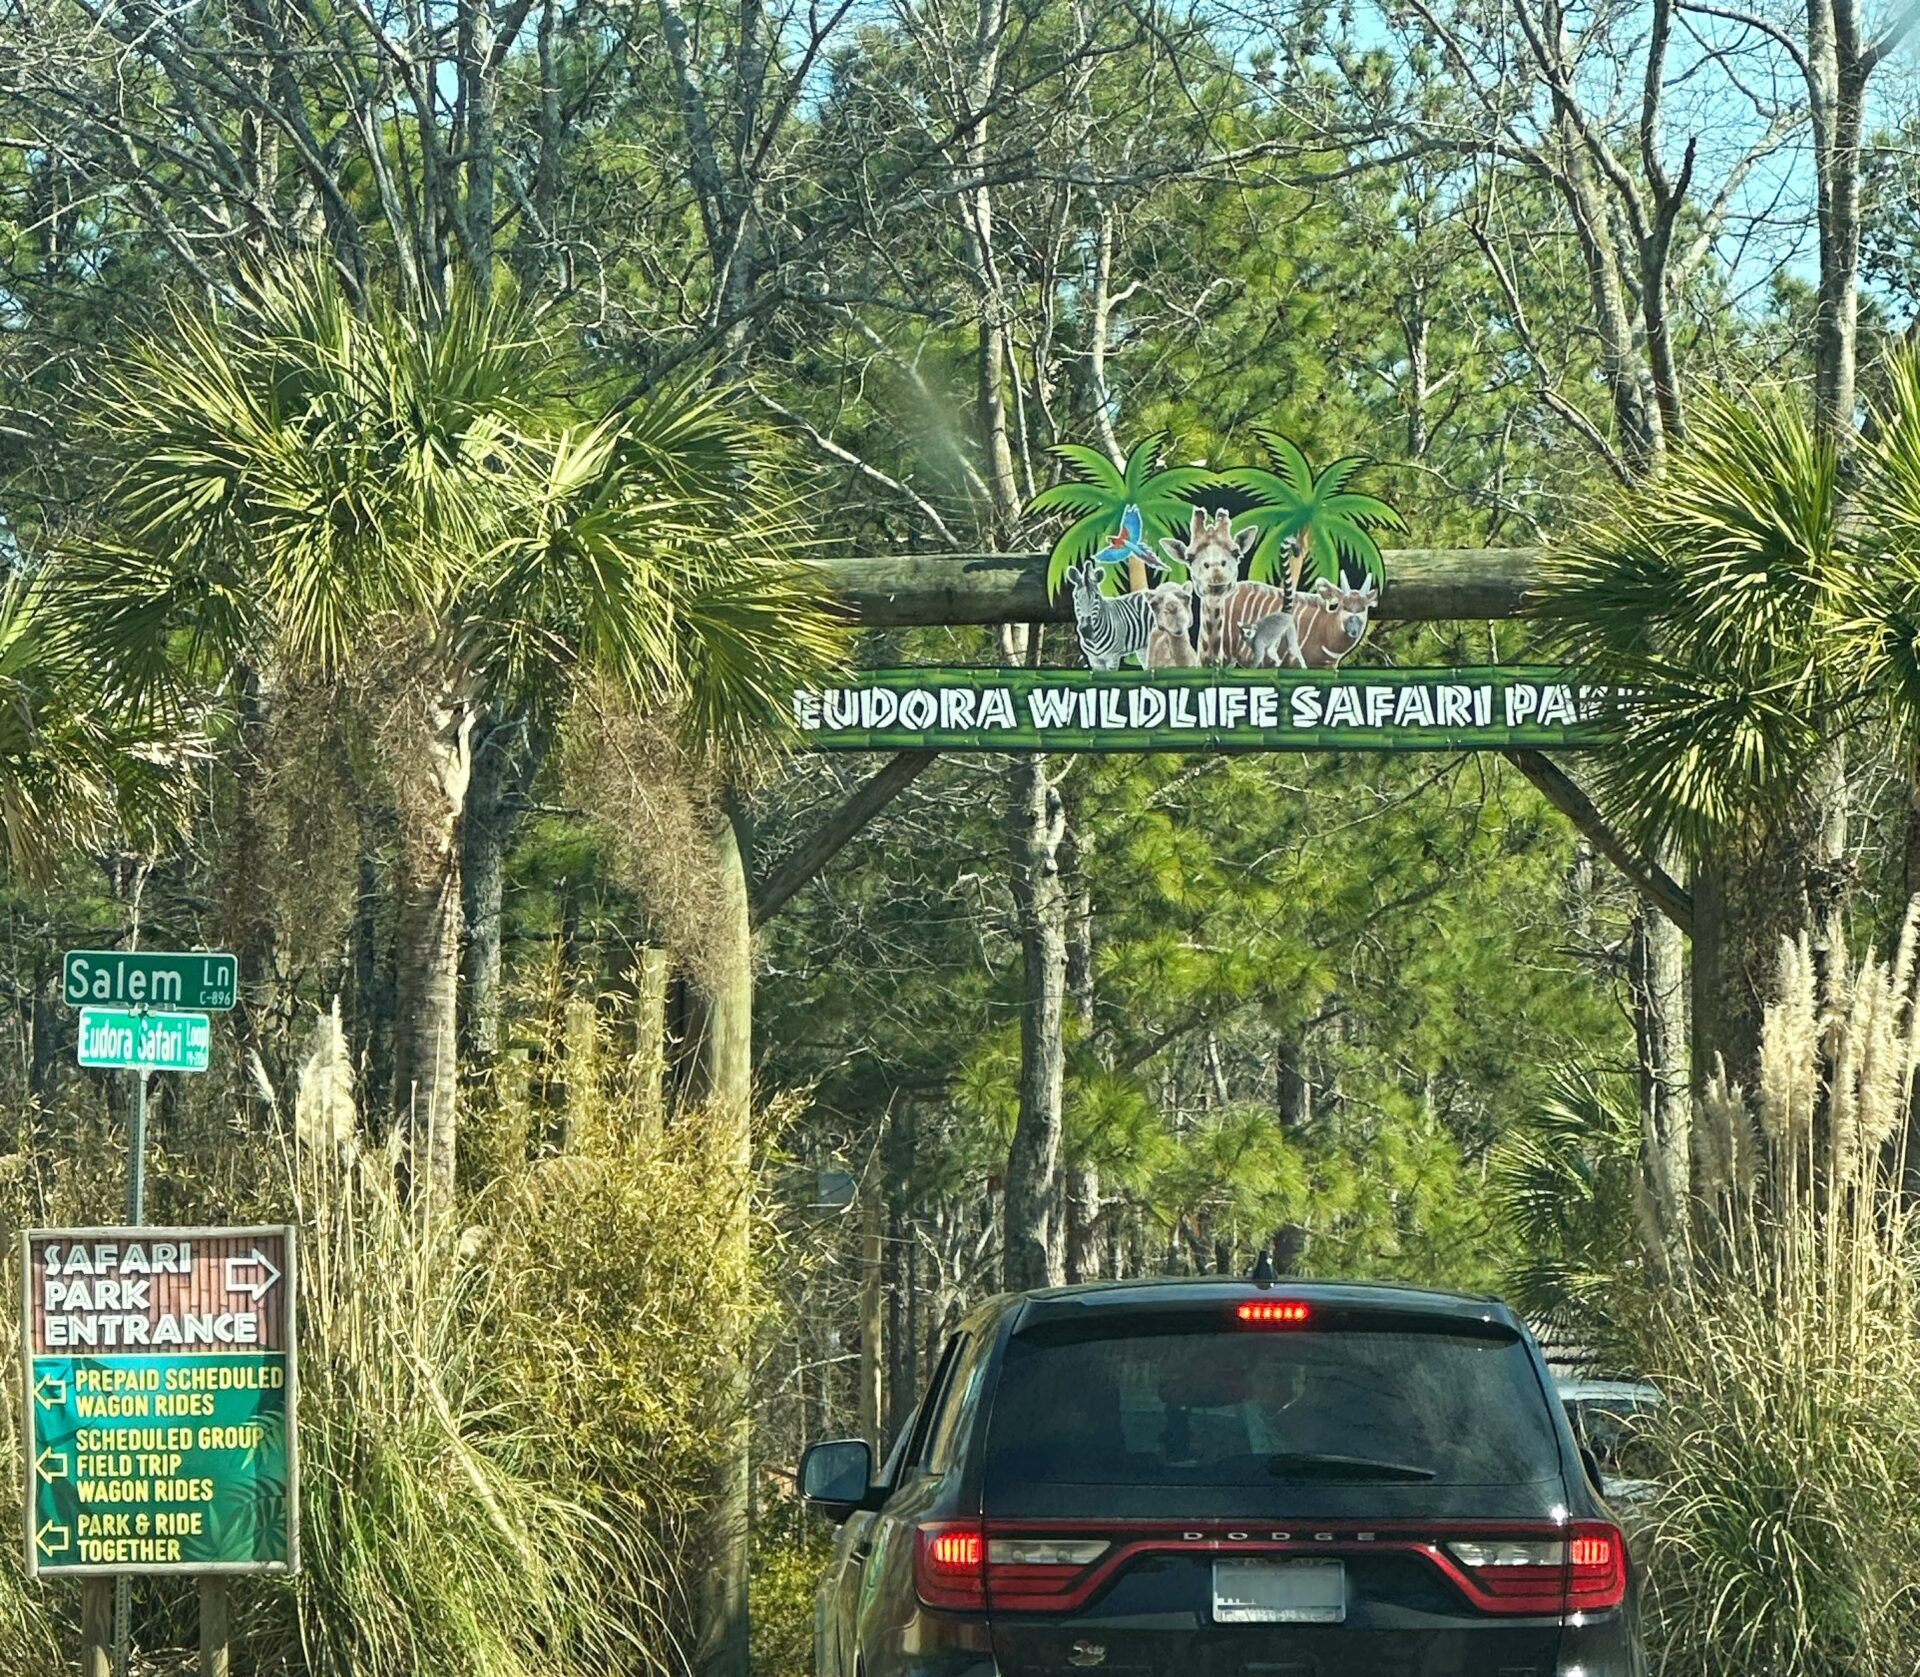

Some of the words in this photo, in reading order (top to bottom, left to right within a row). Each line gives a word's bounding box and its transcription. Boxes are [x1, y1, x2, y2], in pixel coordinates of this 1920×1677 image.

[793, 686, 1018, 731] EUDORA
[1029, 685, 1278, 730] WILDLIFE
[1291, 684, 1492, 729] SAFARI
[68, 958, 182, 1001] Salem
[203, 959, 229, 987] Ln
[199, 991, 231, 1006] C-896
[80, 1017, 132, 1060] Eudora
[137, 1019, 182, 1062] Safari
[44, 1242, 192, 1276] SAFARI
[44, 1279, 151, 1311] PARK
[45, 1312, 258, 1346] ENTRANCE
[75, 1369, 159, 1392] PREPAID
[165, 1367, 285, 1390] SCHEDULED
[75, 1394, 148, 1418] WAGON
[155, 1393, 214, 1417] RIDES
[75, 1427, 193, 1451] SCHEDULED
[198, 1426, 265, 1450] GROUP
[76, 1454, 132, 1477] FIELD
[136, 1454, 182, 1477] TRIP
[76, 1480, 148, 1503] WAGON
[154, 1478, 214, 1502] RIDES
[77, 1513, 131, 1537] PARK
[135, 1513, 150, 1536] &
[155, 1513, 203, 1535] RIDE
[1183, 1530, 1376, 1542] DODGE
[78, 1539, 181, 1562] TOGETHER
